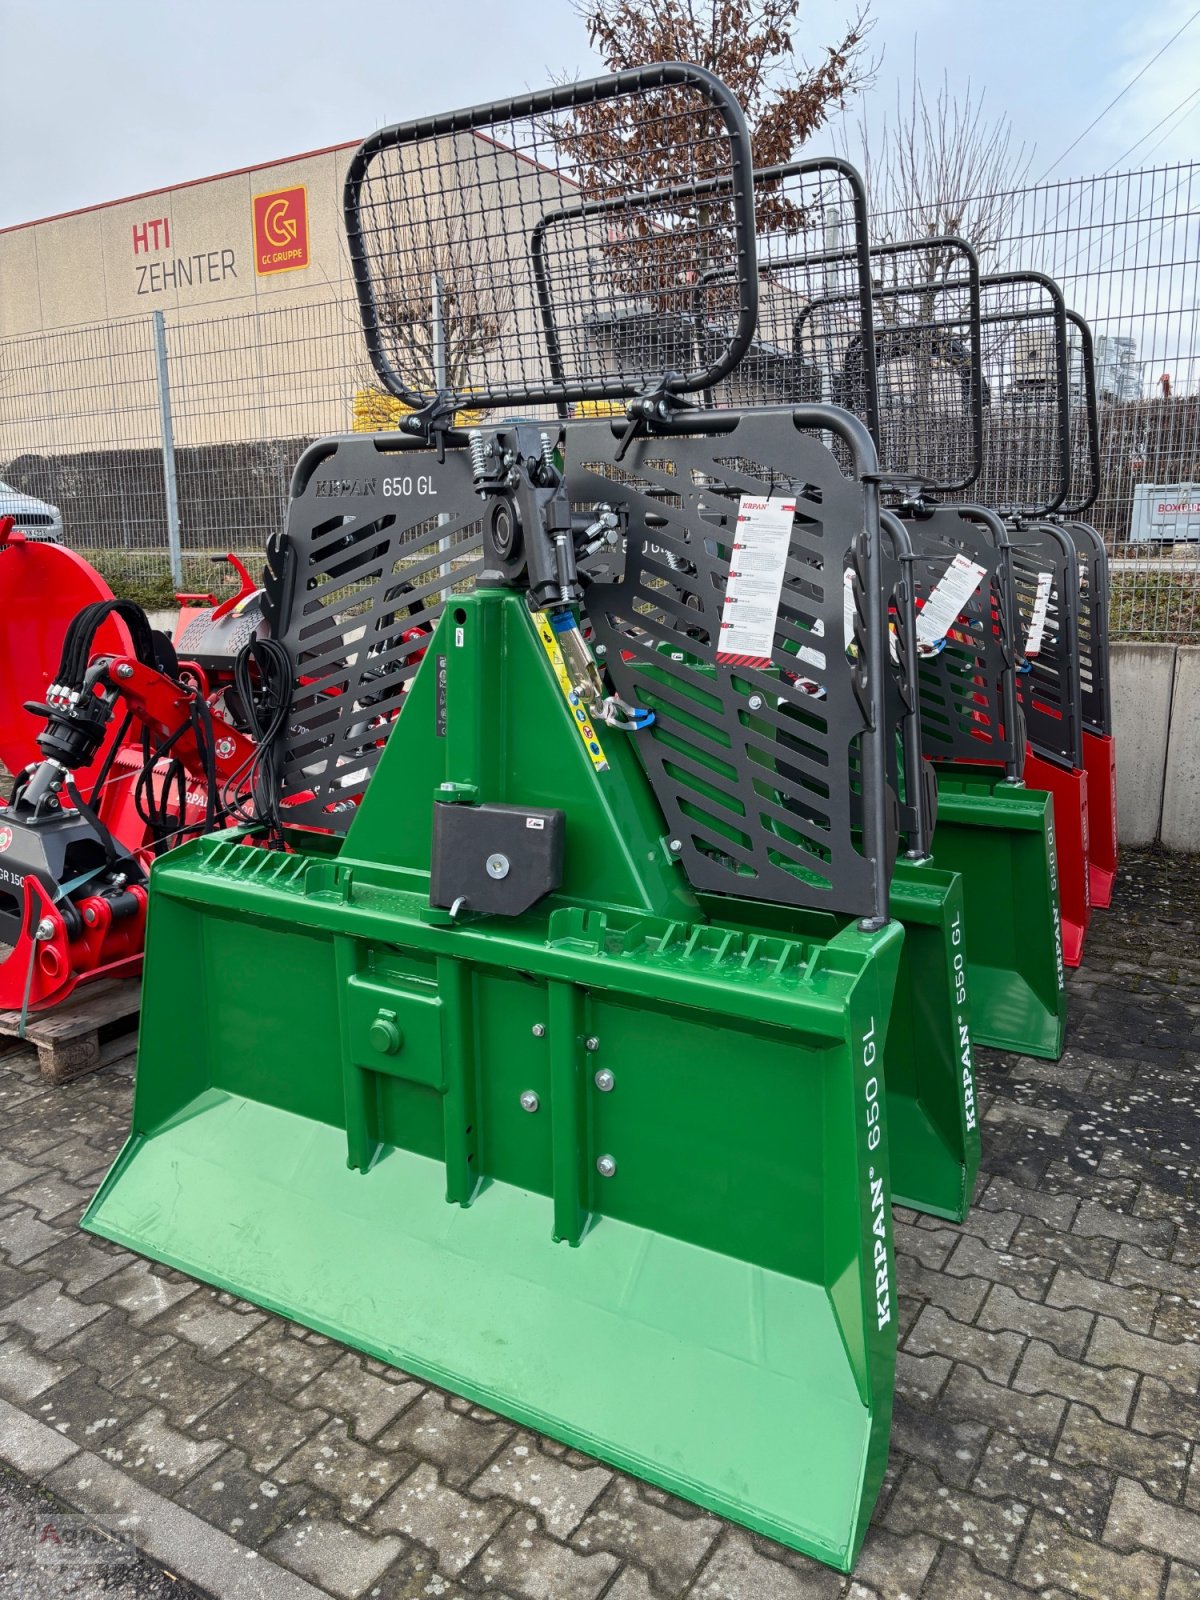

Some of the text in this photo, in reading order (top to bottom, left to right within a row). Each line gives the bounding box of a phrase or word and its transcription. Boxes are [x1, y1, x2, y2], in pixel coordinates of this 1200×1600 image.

[132, 217, 170, 254] HTI
[136, 249, 238, 295] ZEHNTER
[262, 248, 303, 265] GC GRUPPE
[382, 476, 412, 497] 650
[417, 475, 438, 495] GL
[951, 911, 960, 946] GL
[953, 953, 966, 1005] 550
[862, 1016, 876, 1067] GL
[865, 1077, 881, 1151] 650
